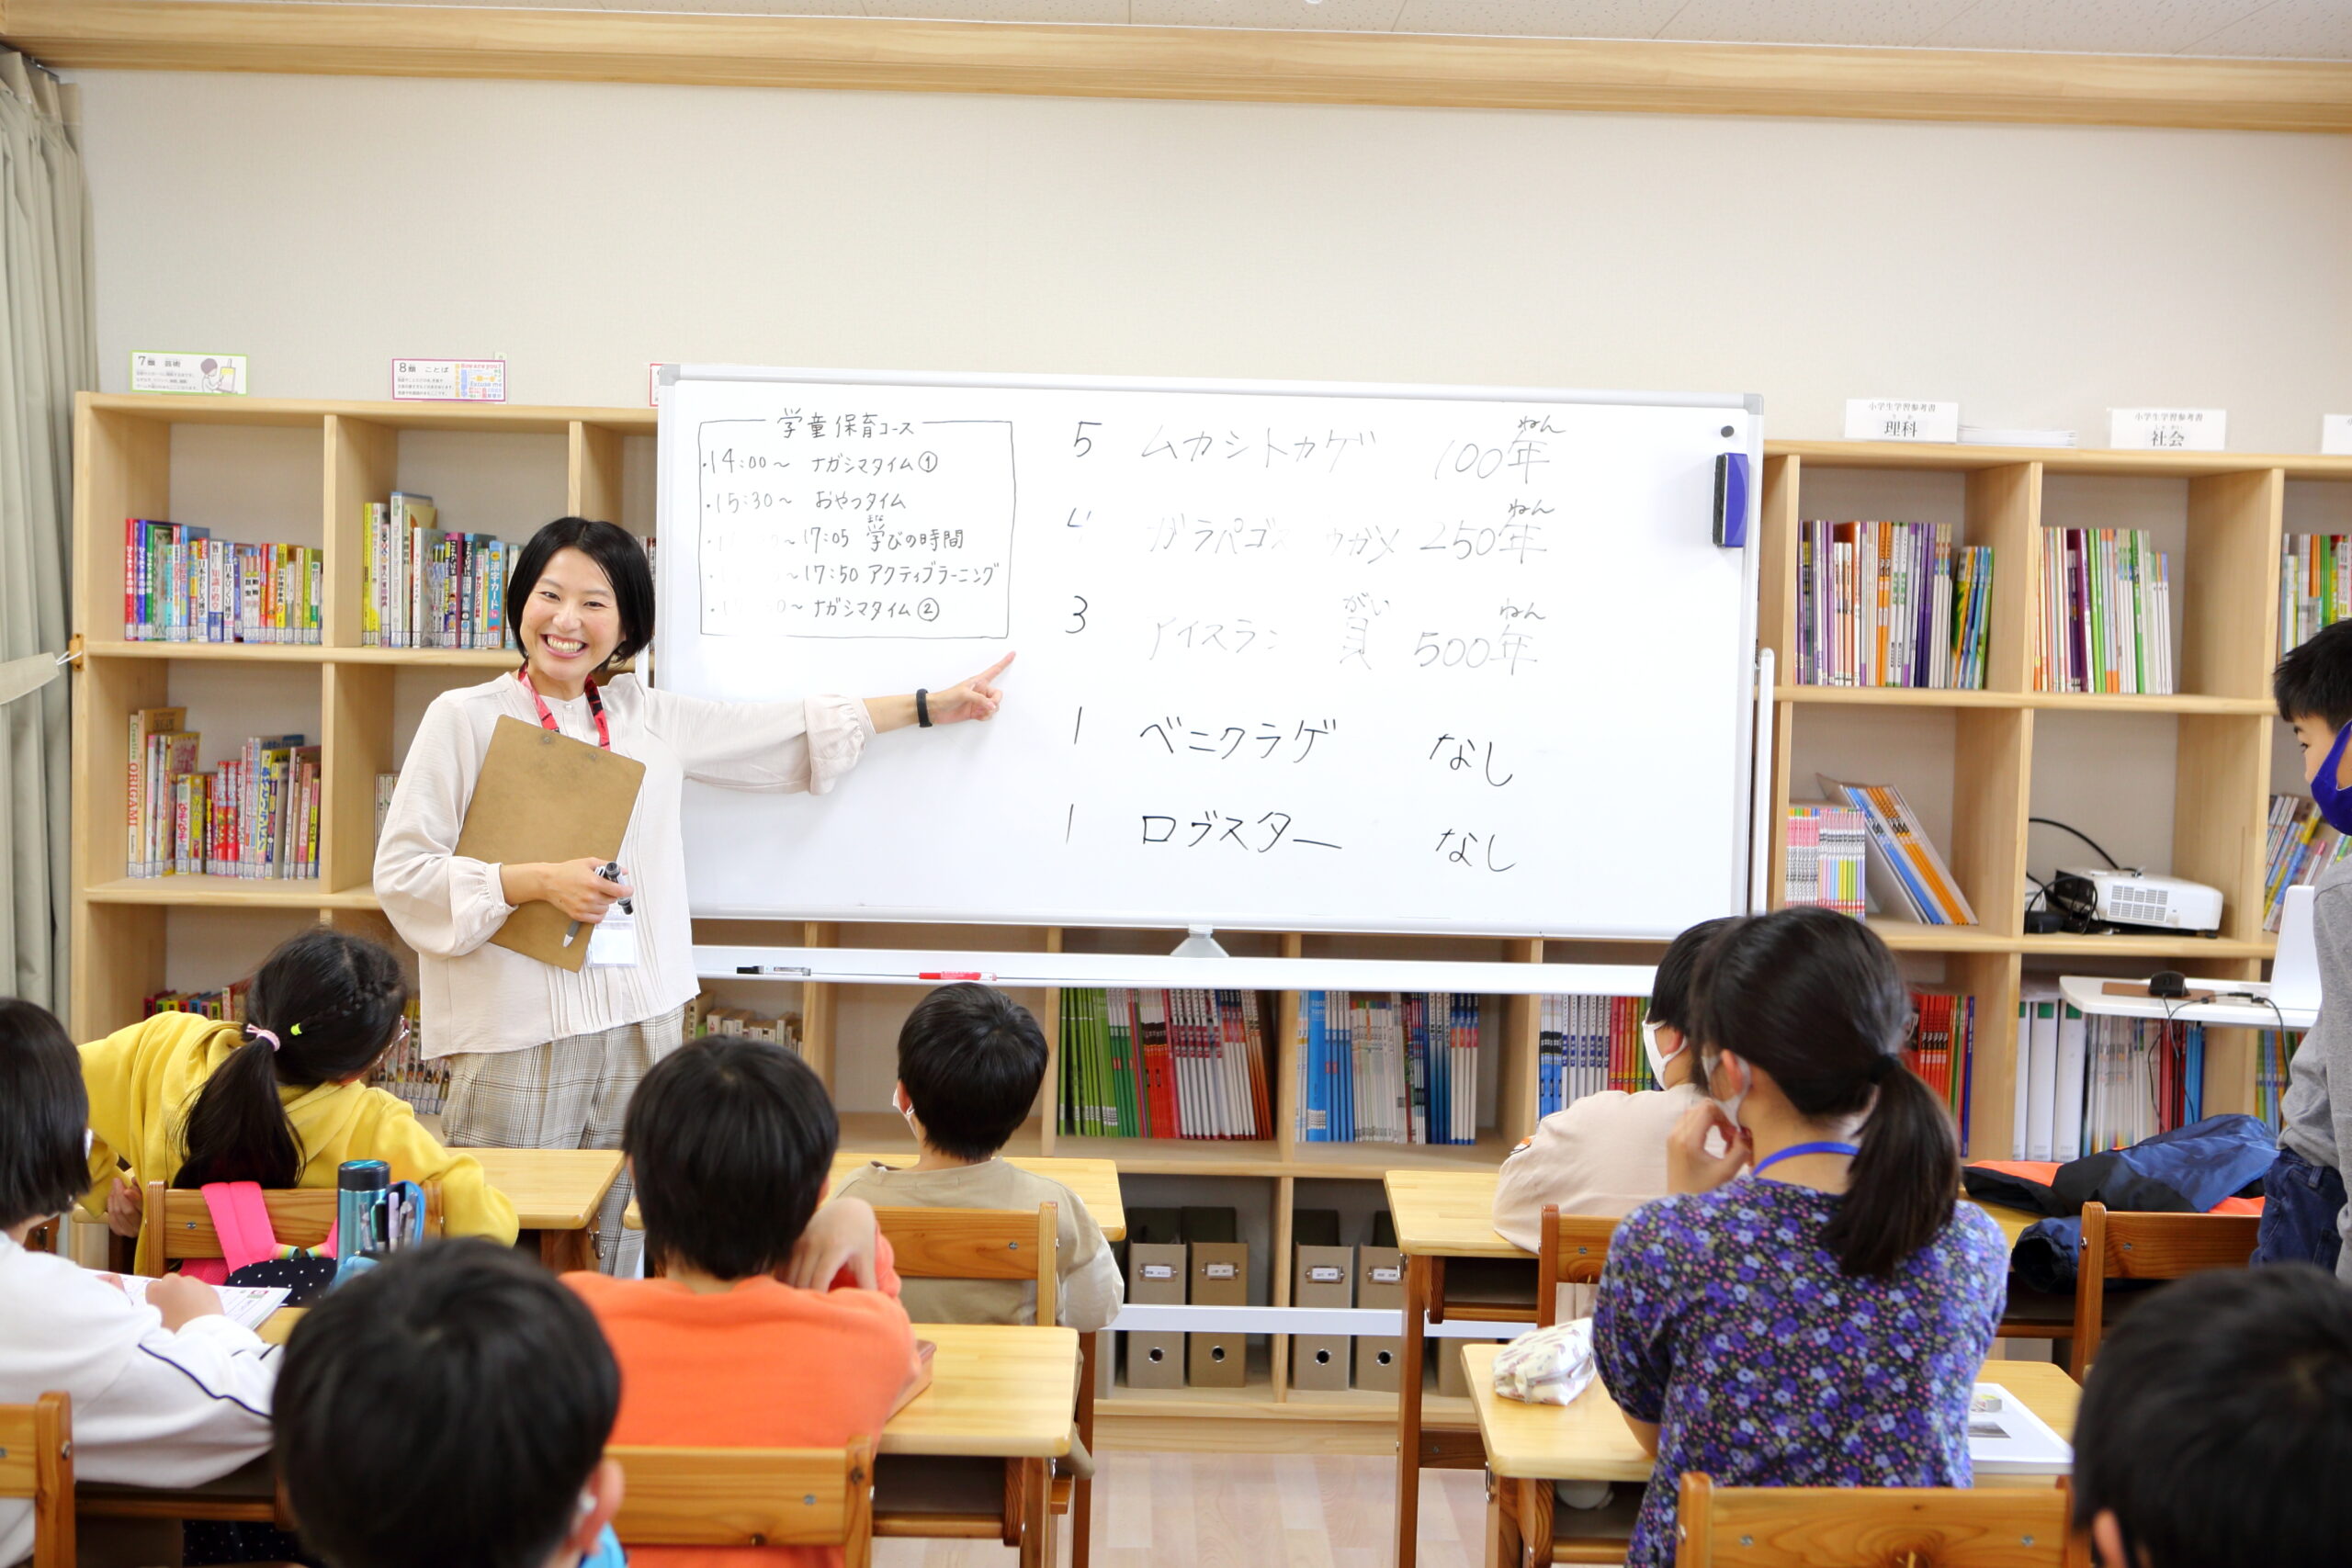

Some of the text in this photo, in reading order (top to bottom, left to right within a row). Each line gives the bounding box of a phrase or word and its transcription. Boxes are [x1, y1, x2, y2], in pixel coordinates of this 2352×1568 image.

[777, 408, 914, 438] 学童保育コース
[1518, 413, 1566, 435] ねん
[1884, 421, 1917, 437] 理科
[2152, 430, 2185, 446] 社会
[1073, 421, 1551, 485] 5 ムカシトカゲ 100年
[815, 490, 907, 512] おやつタイム
[1508, 498, 1556, 518] ねん
[865, 522, 964, 553] 学びの時間
[1419, 514, 1548, 565] 250年
[491, 561, 500, 609] 漢字カード
[867, 560, 1000, 588] アクティブラーニング
[1499, 598, 1547, 621] ねん
[1065, 595, 1089, 635] 3
[1414, 624, 1539, 676] 500年
[1139, 716, 1337, 763] ベニクラゲ
[1429, 733, 1514, 787] なし
[128, 762, 138, 827] ORIGAMI
[1142, 809, 1343, 853] ロブスター
[1435, 829, 1518, 873] なし
